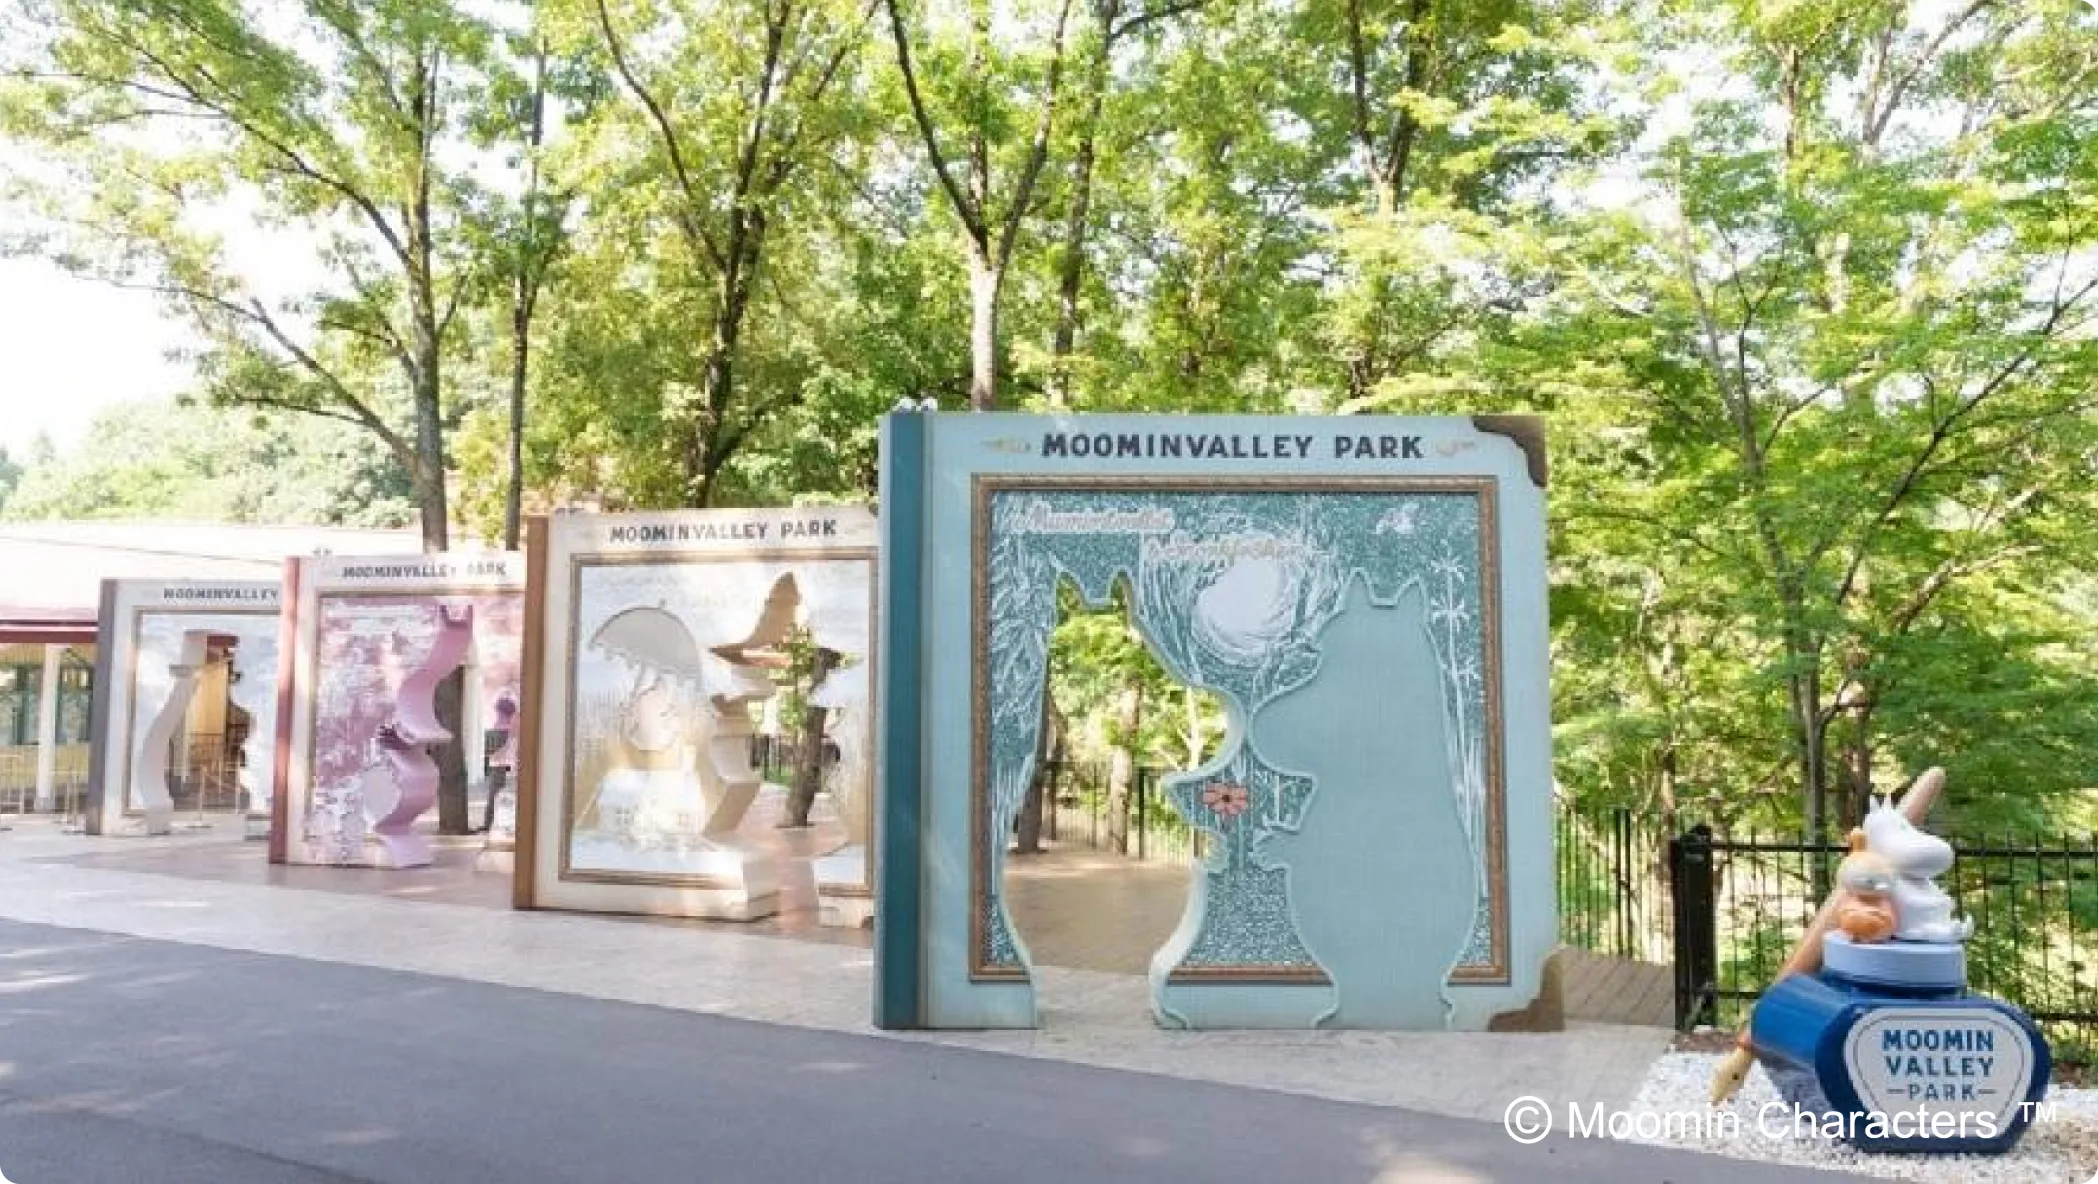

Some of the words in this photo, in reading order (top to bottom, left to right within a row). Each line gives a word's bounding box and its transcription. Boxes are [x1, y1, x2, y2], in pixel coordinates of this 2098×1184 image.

[1042, 432, 1313, 459] MOOMINVALLEY
[1334, 434, 1424, 460] PARK
[609, 524, 768, 542] MOOMINVALLEY
[780, 519, 837, 538] PARK
[1883, 1029, 1994, 1051] MOOMIN
[1884, 1056, 1994, 1076] VALLEY
[1908, 1083, 1975, 1101] PARK
